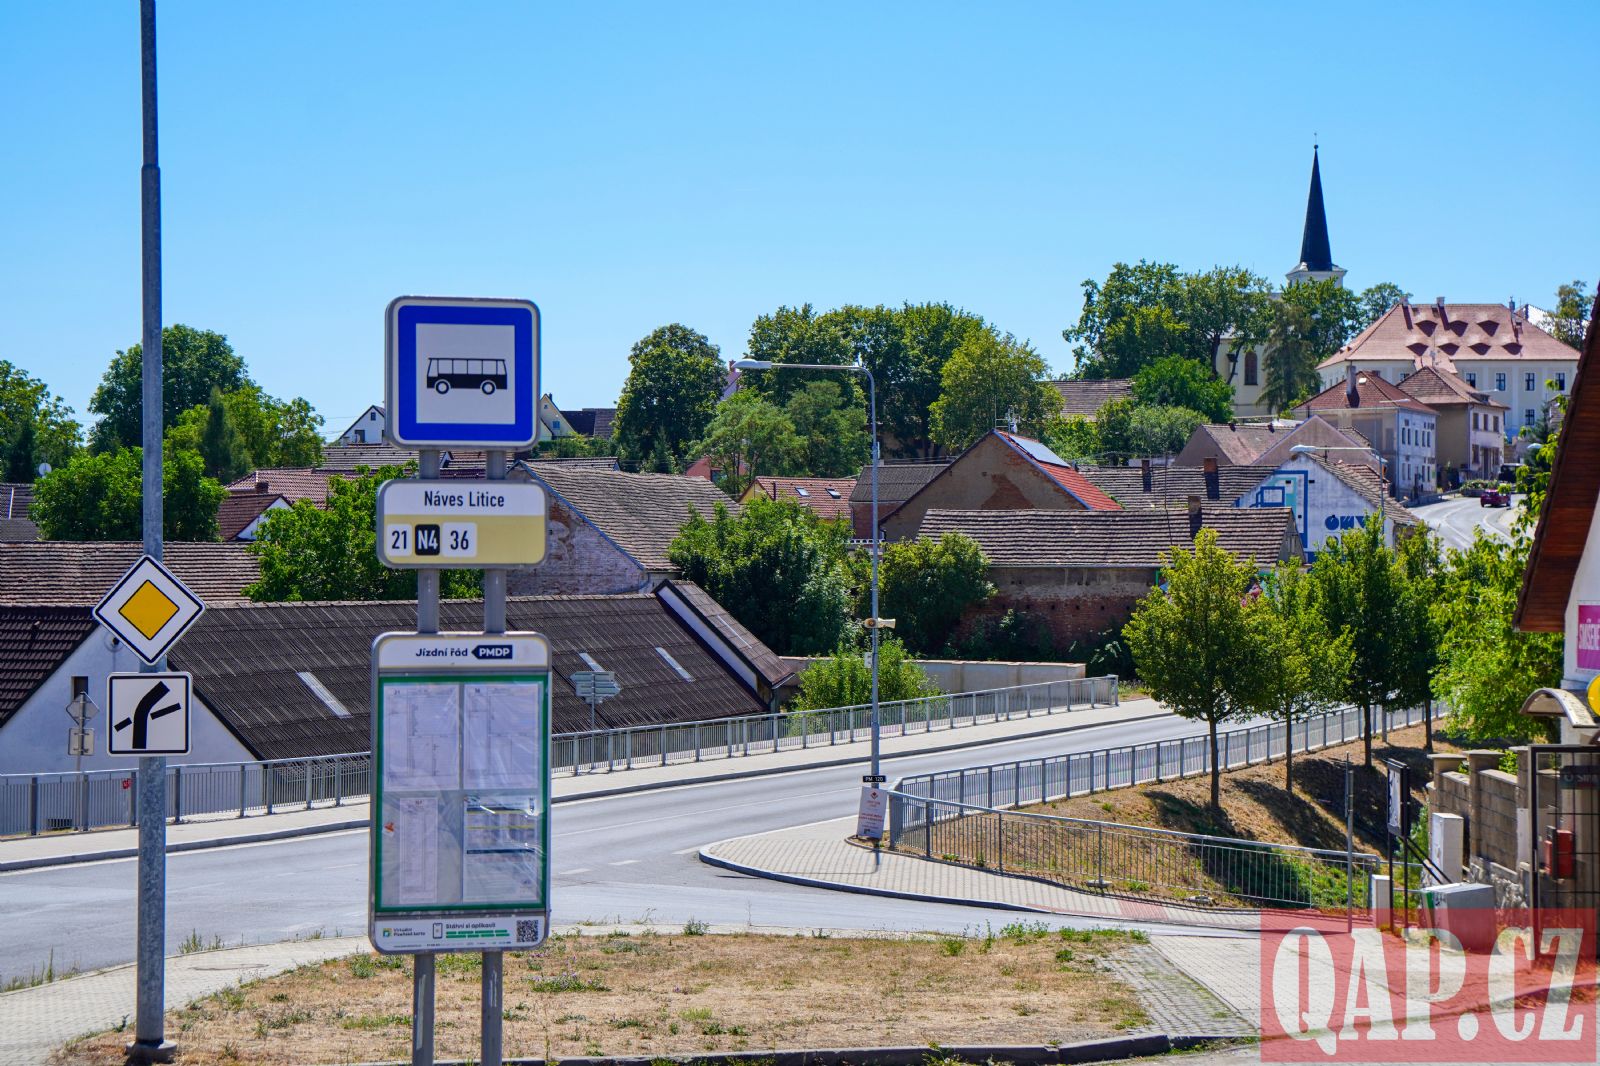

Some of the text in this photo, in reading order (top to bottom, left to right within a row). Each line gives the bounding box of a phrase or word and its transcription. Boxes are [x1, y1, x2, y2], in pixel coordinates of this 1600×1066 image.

[424, 490, 505, 507] Náves Litice
[391, 530, 469, 550] 21 N4 36
[415, 647, 511, 657] Jízdní řád PMDP
